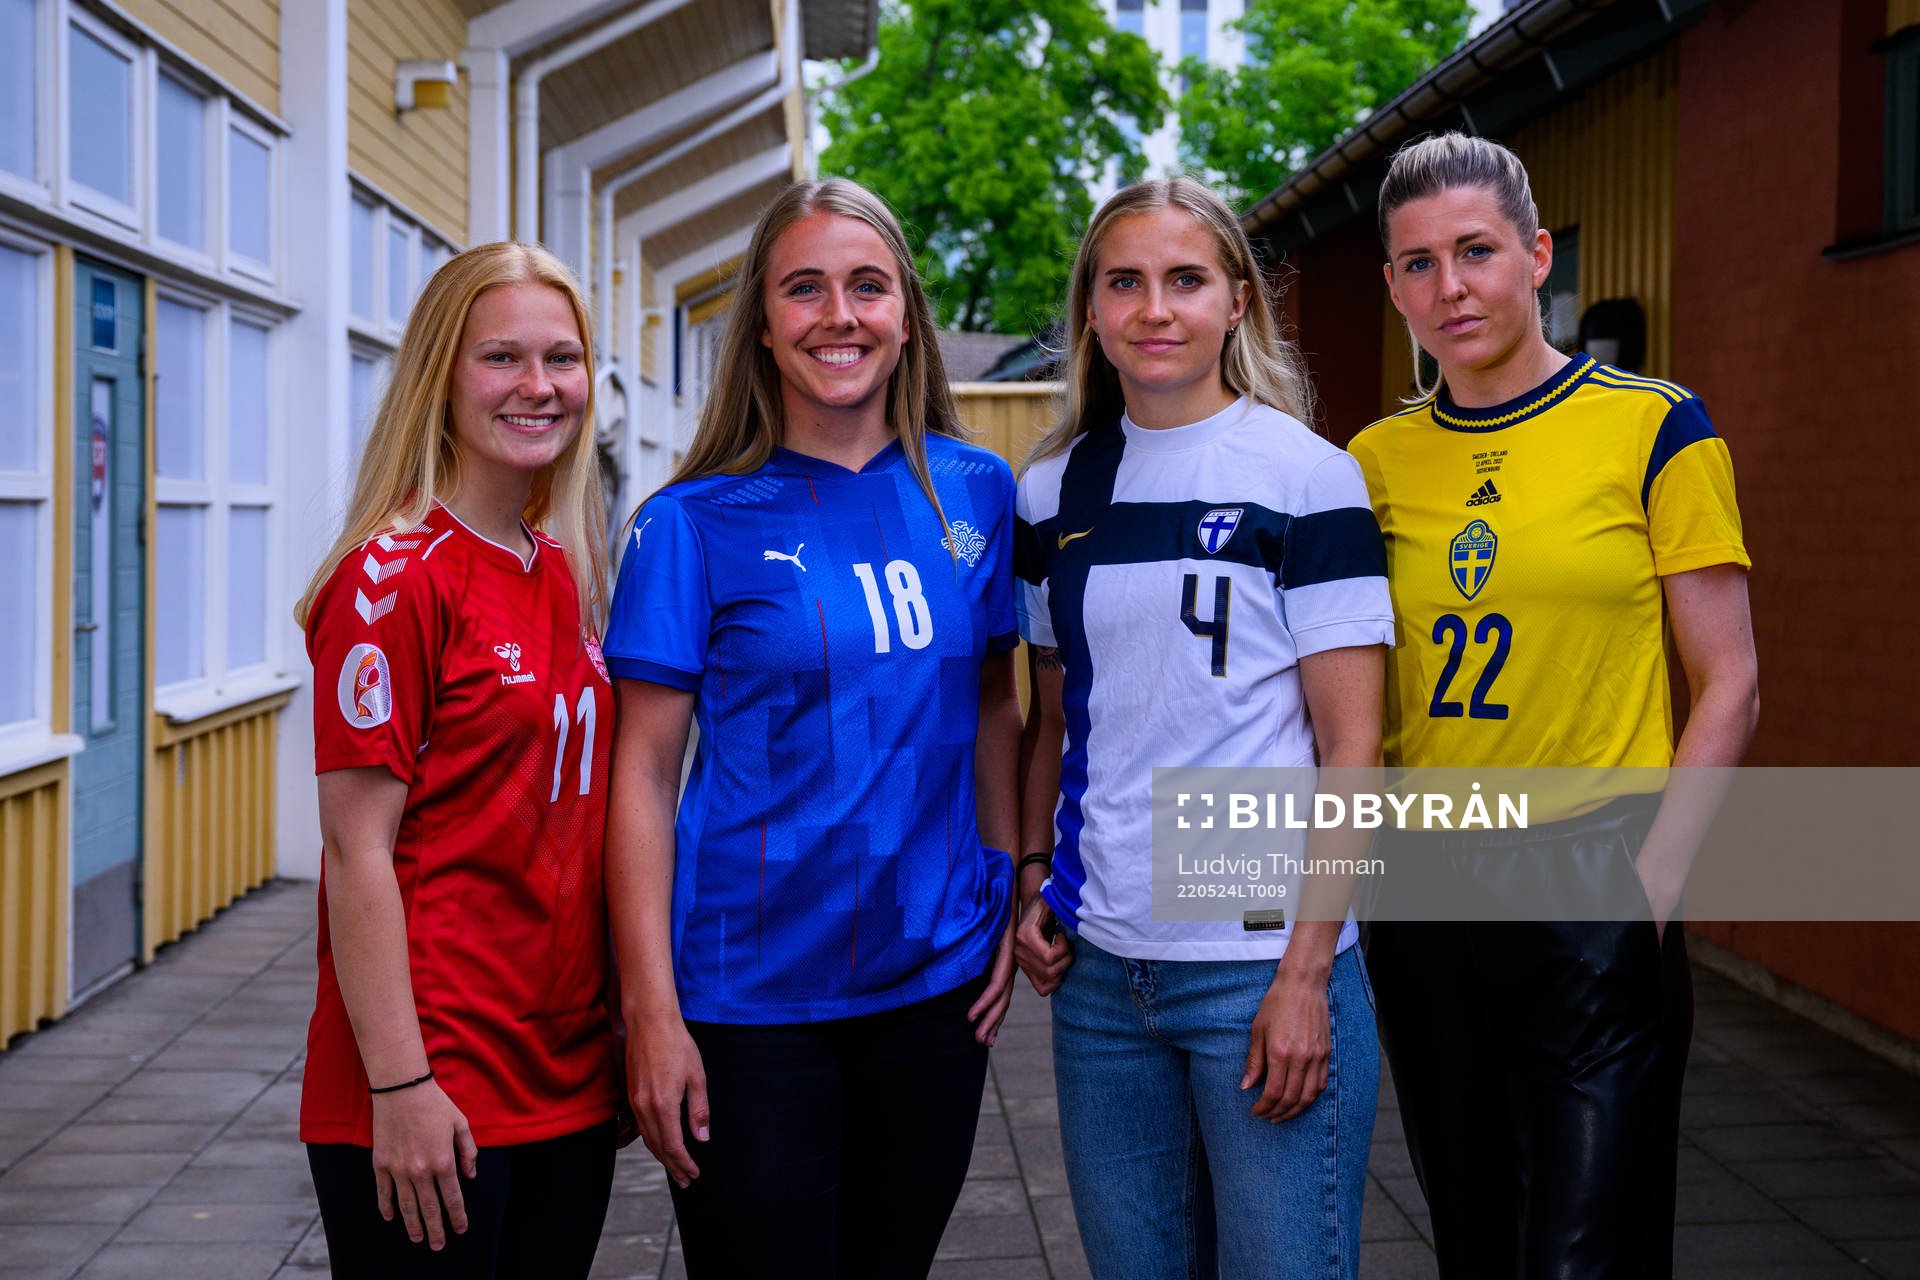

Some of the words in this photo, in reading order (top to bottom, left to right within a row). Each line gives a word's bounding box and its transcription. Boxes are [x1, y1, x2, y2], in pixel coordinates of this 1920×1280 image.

[1466, 494, 1502, 507] adidas
[1472, 452, 1487, 460] SWEDEN
[852, 559, 934, 654] 18
[1180, 573, 1231, 679] 4
[501, 671, 537, 686] hummel
[1429, 612, 1513, 720] 22
[550, 686, 597, 803] 11
